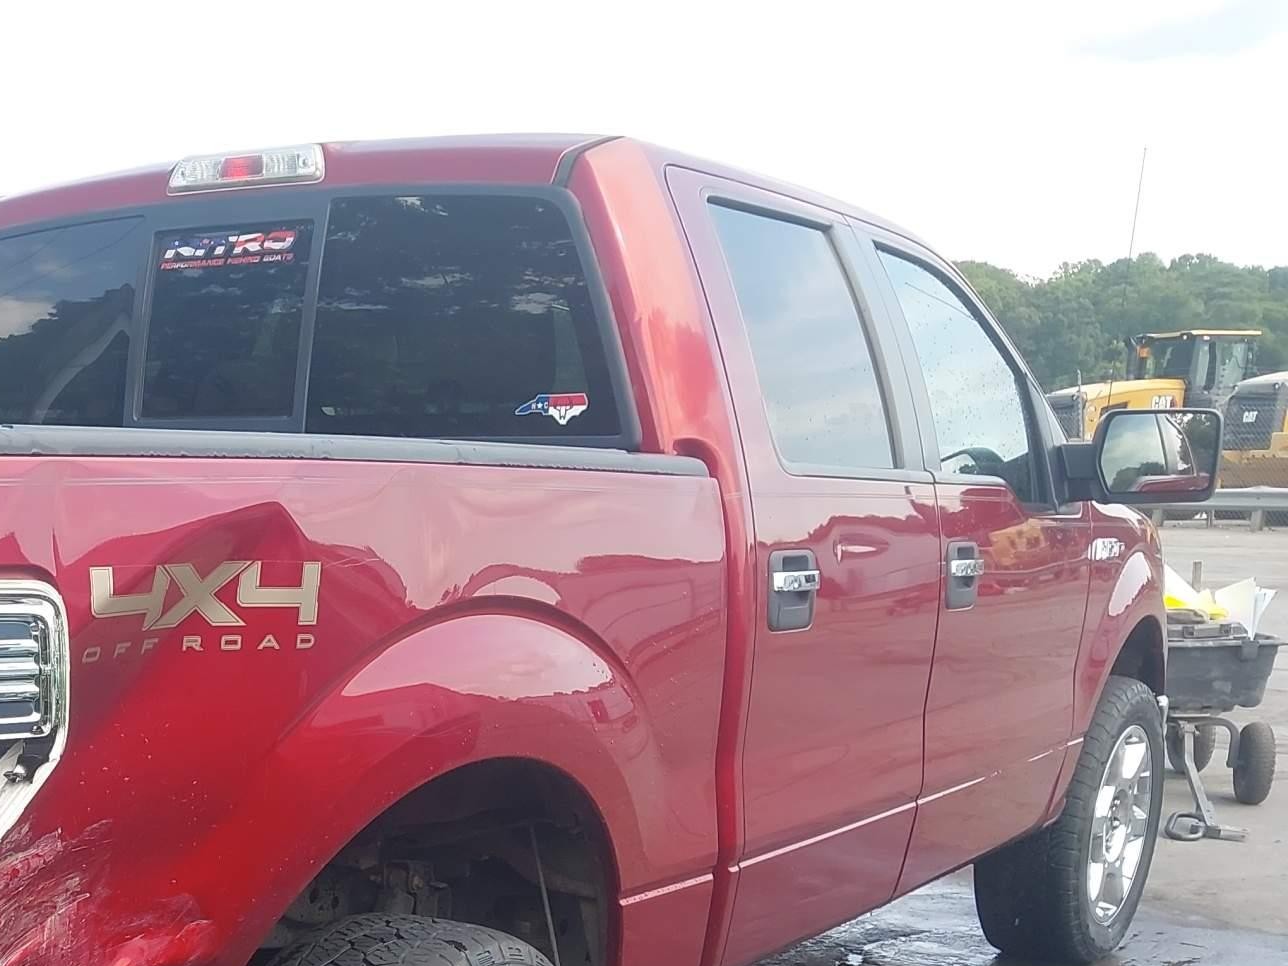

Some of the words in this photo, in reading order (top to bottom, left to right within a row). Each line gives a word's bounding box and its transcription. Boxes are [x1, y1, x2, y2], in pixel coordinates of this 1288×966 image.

[163, 230, 296, 259] NITRO
[1151, 395, 1173, 409] CAT
[1243, 411, 1258, 423] CAT
[89, 560, 322, 631] 4X4
[81, 638, 159, 663] OFF
[182, 633, 316, 652] ROAD
